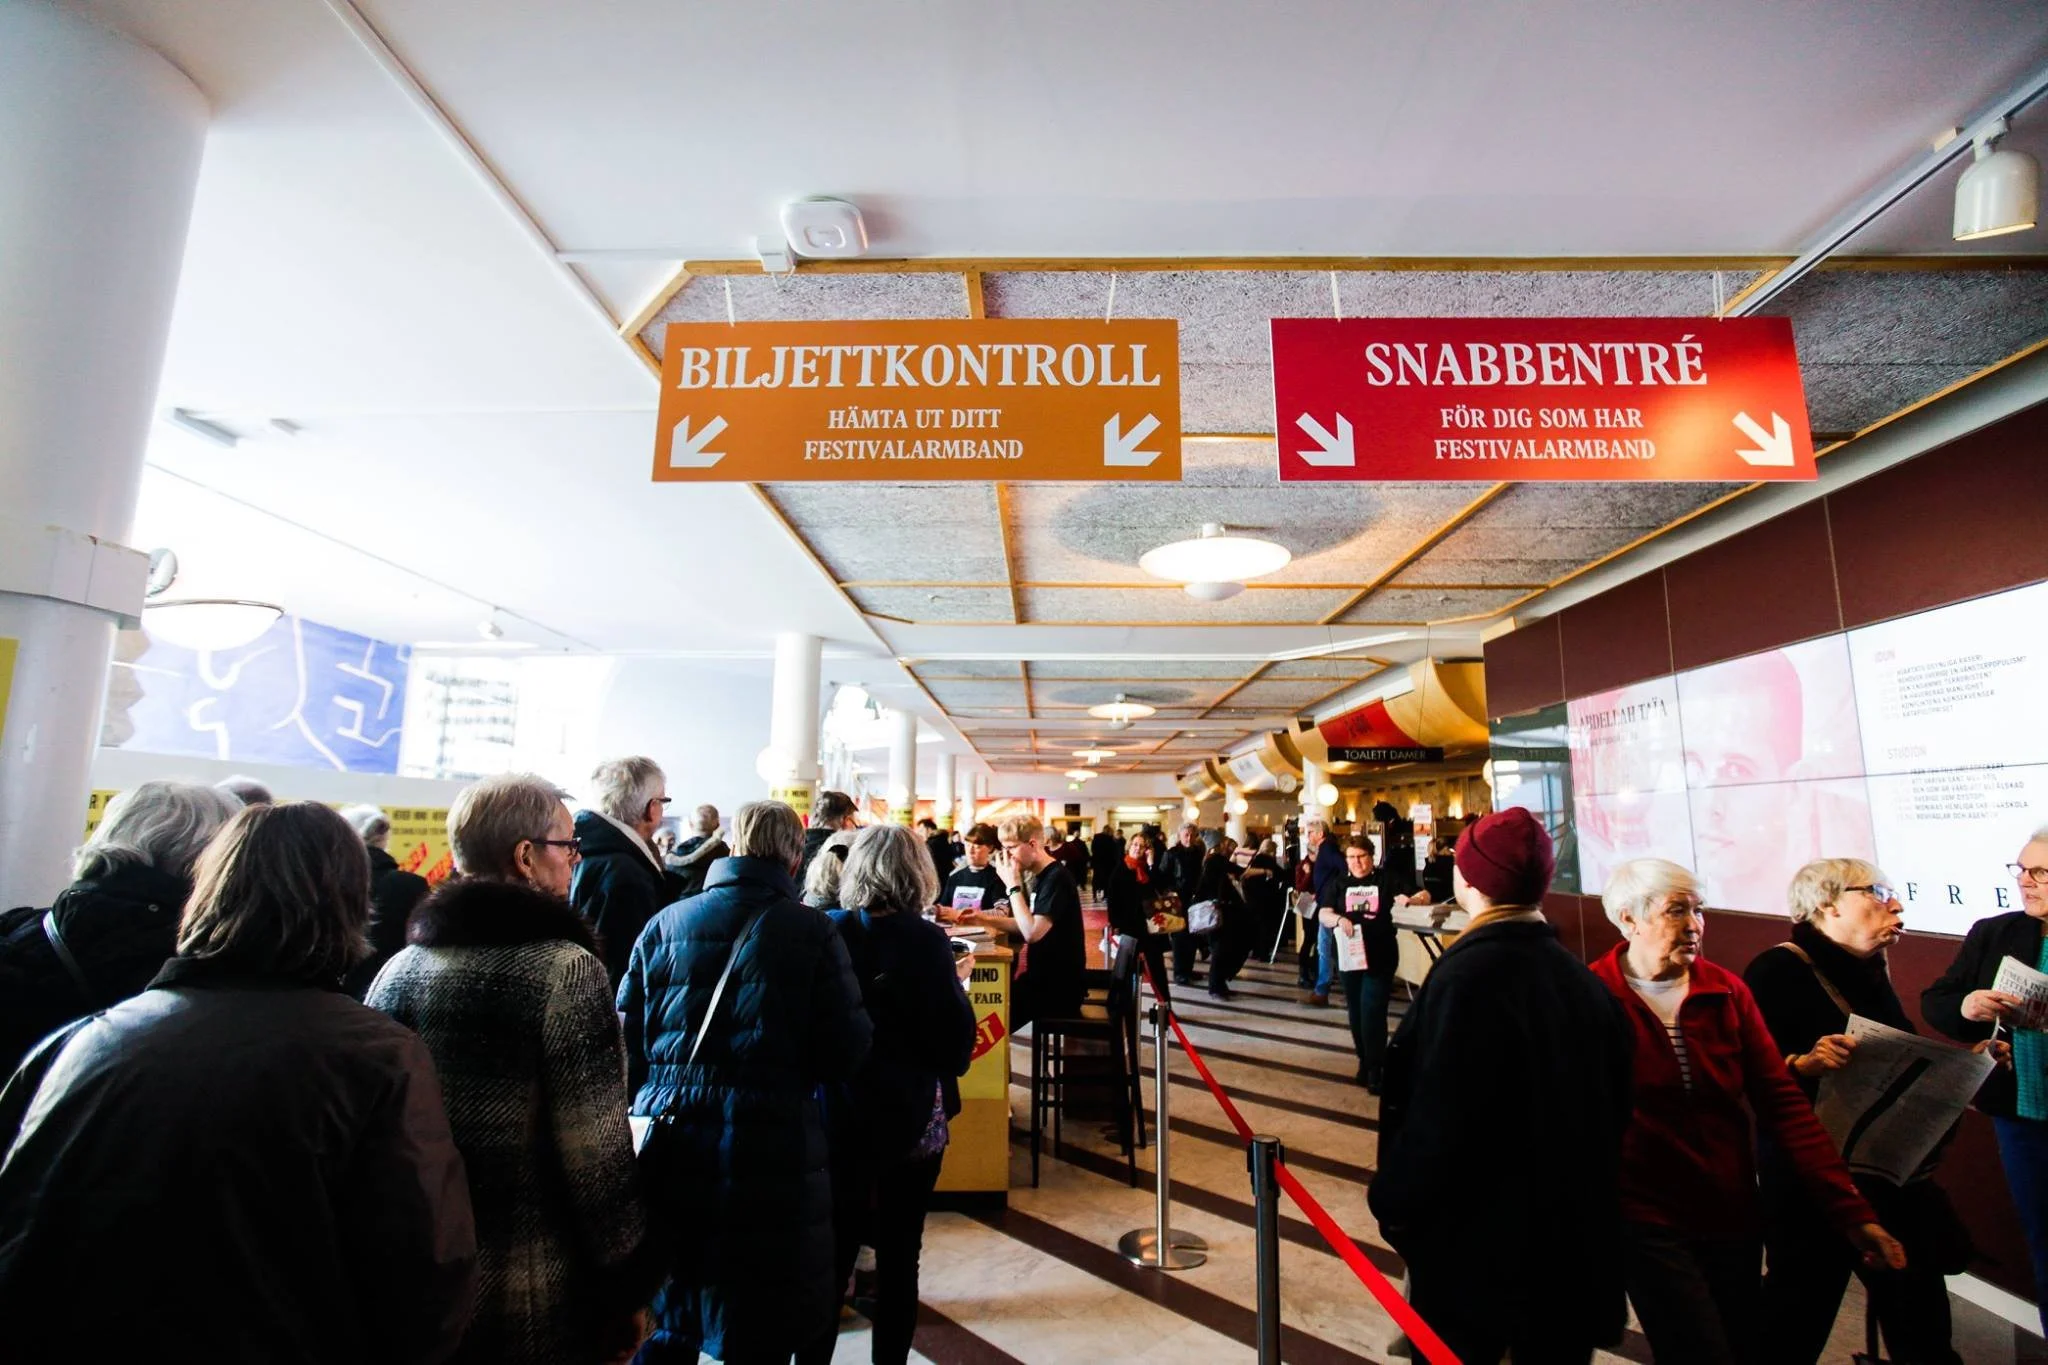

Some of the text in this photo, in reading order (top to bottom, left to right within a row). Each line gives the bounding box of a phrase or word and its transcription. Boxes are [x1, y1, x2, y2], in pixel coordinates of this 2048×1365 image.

[677, 343, 1161, 389] BILJETTKONTROLL
[1366, 334, 1707, 388] SNABBENTRÉ
[828, 405, 1002, 430] HÄMTA UT DITT
[1441, 404, 1644, 429] FÖR DIG SOM HAR
[804, 439, 1024, 461] FESTIVALARMBAND
[1435, 438, 1656, 461] FESTIVALARMBAND
[1345, 749, 1426, 760] TOALETT DAMER
[974, 992, 1002, 1005] FAIR
